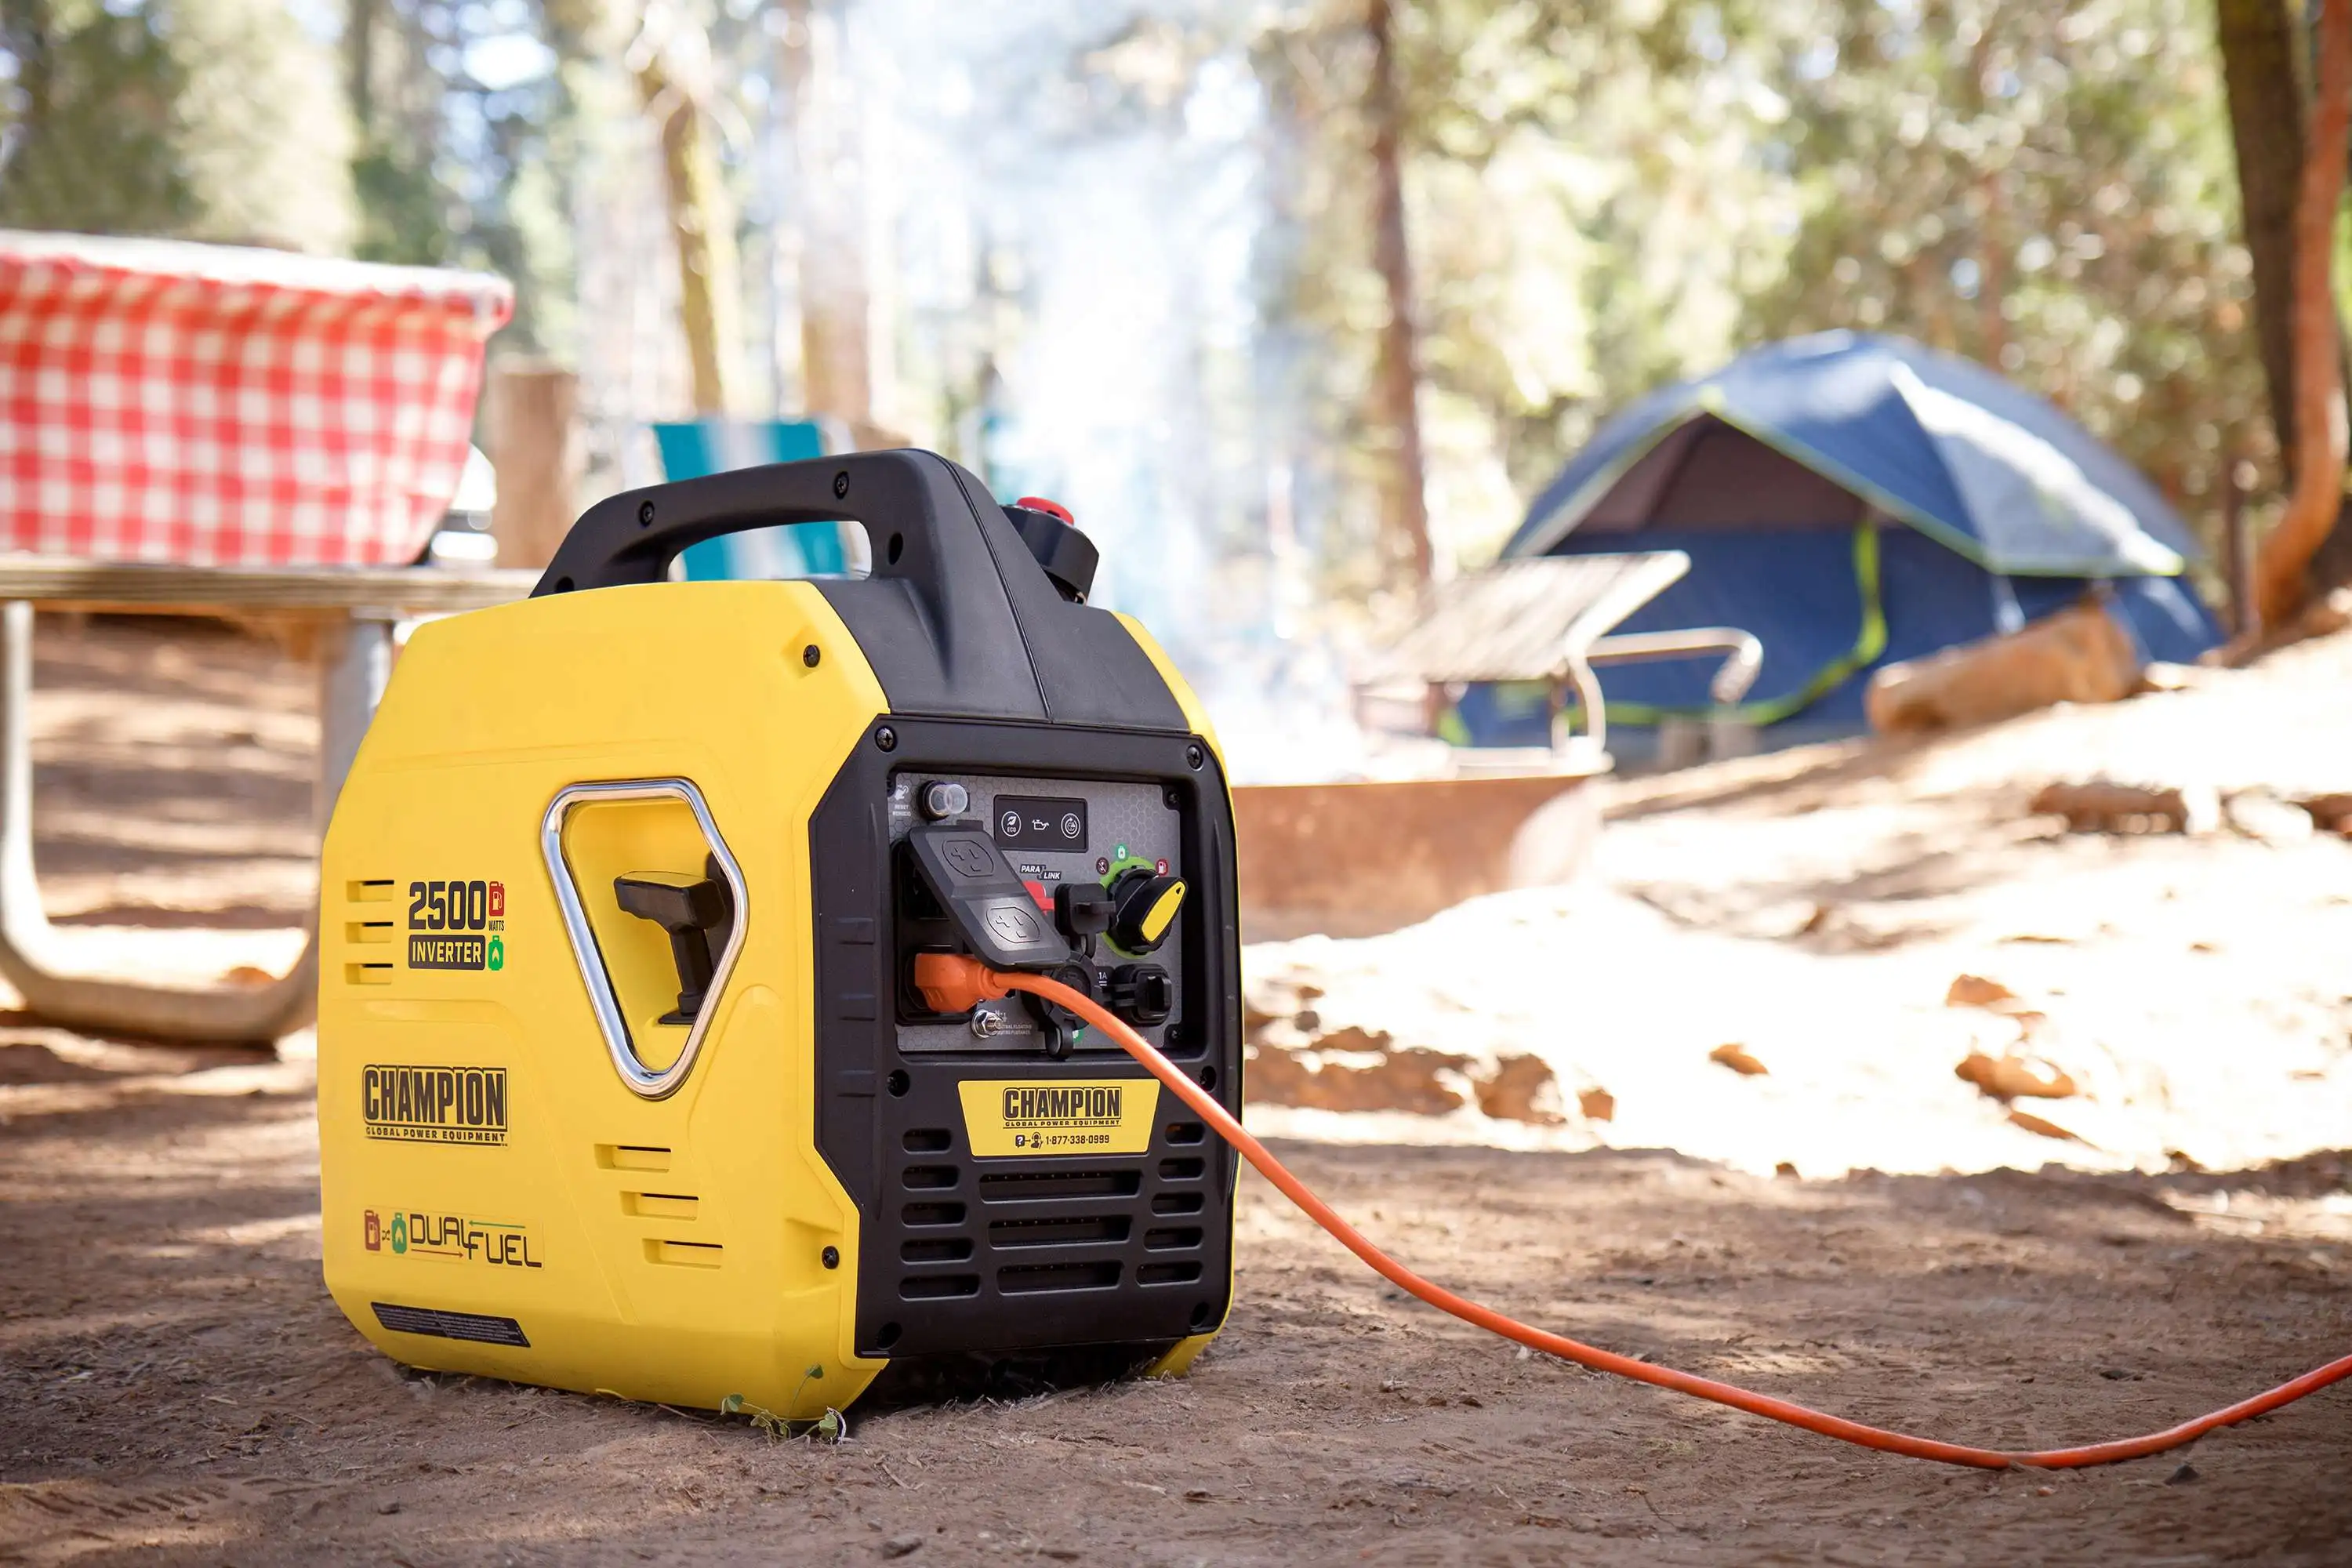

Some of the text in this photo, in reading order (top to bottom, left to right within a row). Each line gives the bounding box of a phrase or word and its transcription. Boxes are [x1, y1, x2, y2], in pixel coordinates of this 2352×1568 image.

[408, 880, 486, 931] 2500
[488, 920, 504, 931] WATTS
[412, 941, 482, 964] INVERTER
[365, 1069, 504, 1127] CHAMPION
[1004, 1089, 1120, 1119] CHAMPION
[365, 1126, 506, 1142] GLOBAL POWER EQUIPMENT
